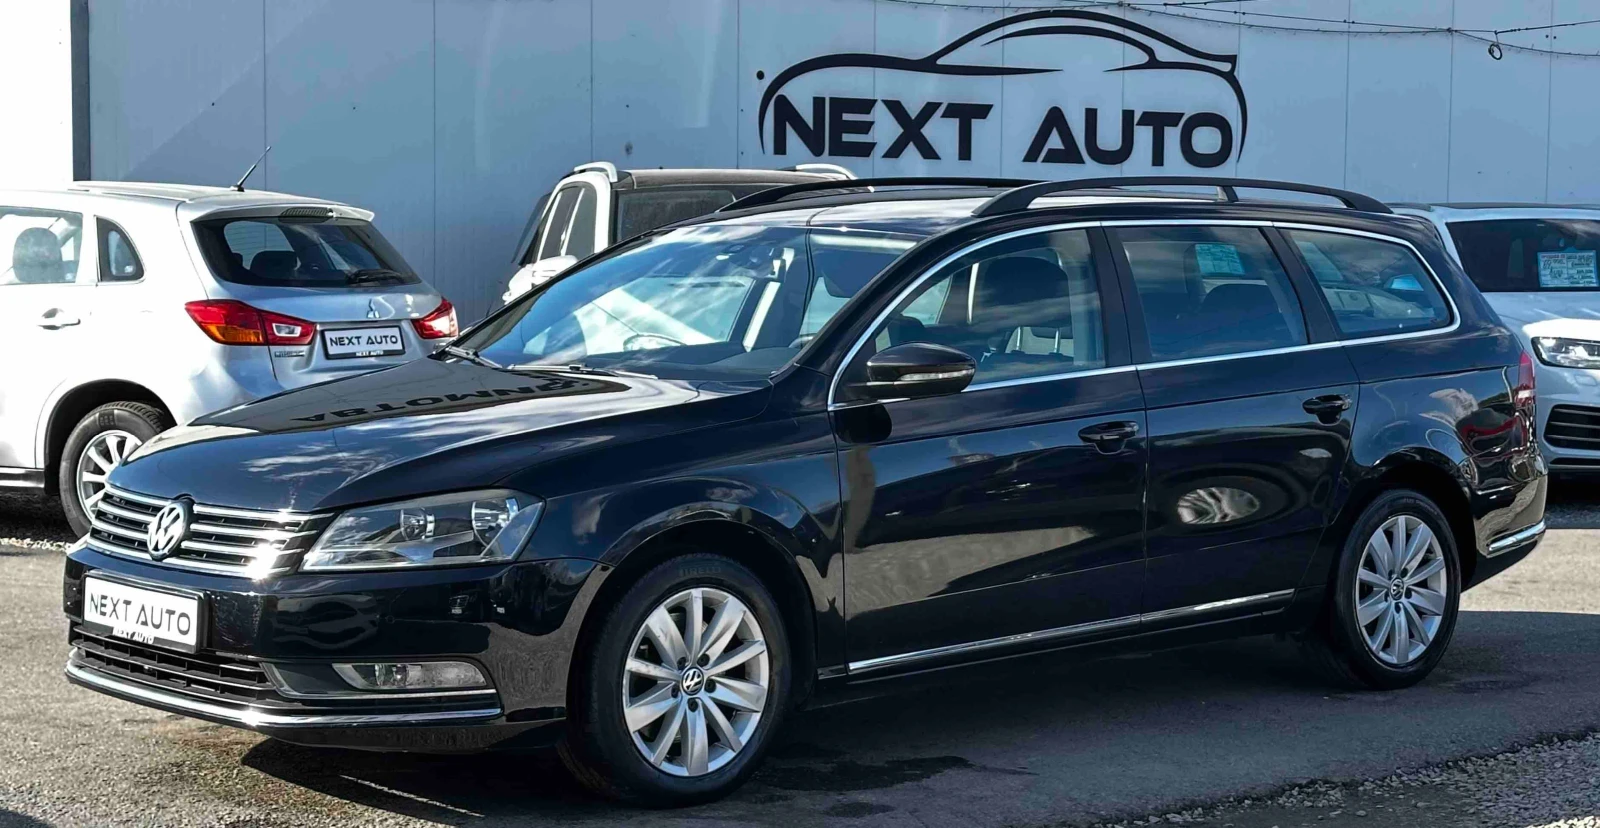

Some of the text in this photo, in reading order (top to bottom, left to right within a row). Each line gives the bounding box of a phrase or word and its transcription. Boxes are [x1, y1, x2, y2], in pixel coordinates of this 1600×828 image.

[773, 94, 1234, 168] NEXT AUTO
[329, 334, 399, 347] NEXT AUTO
[89, 592, 191, 636] NEXT AUTO
